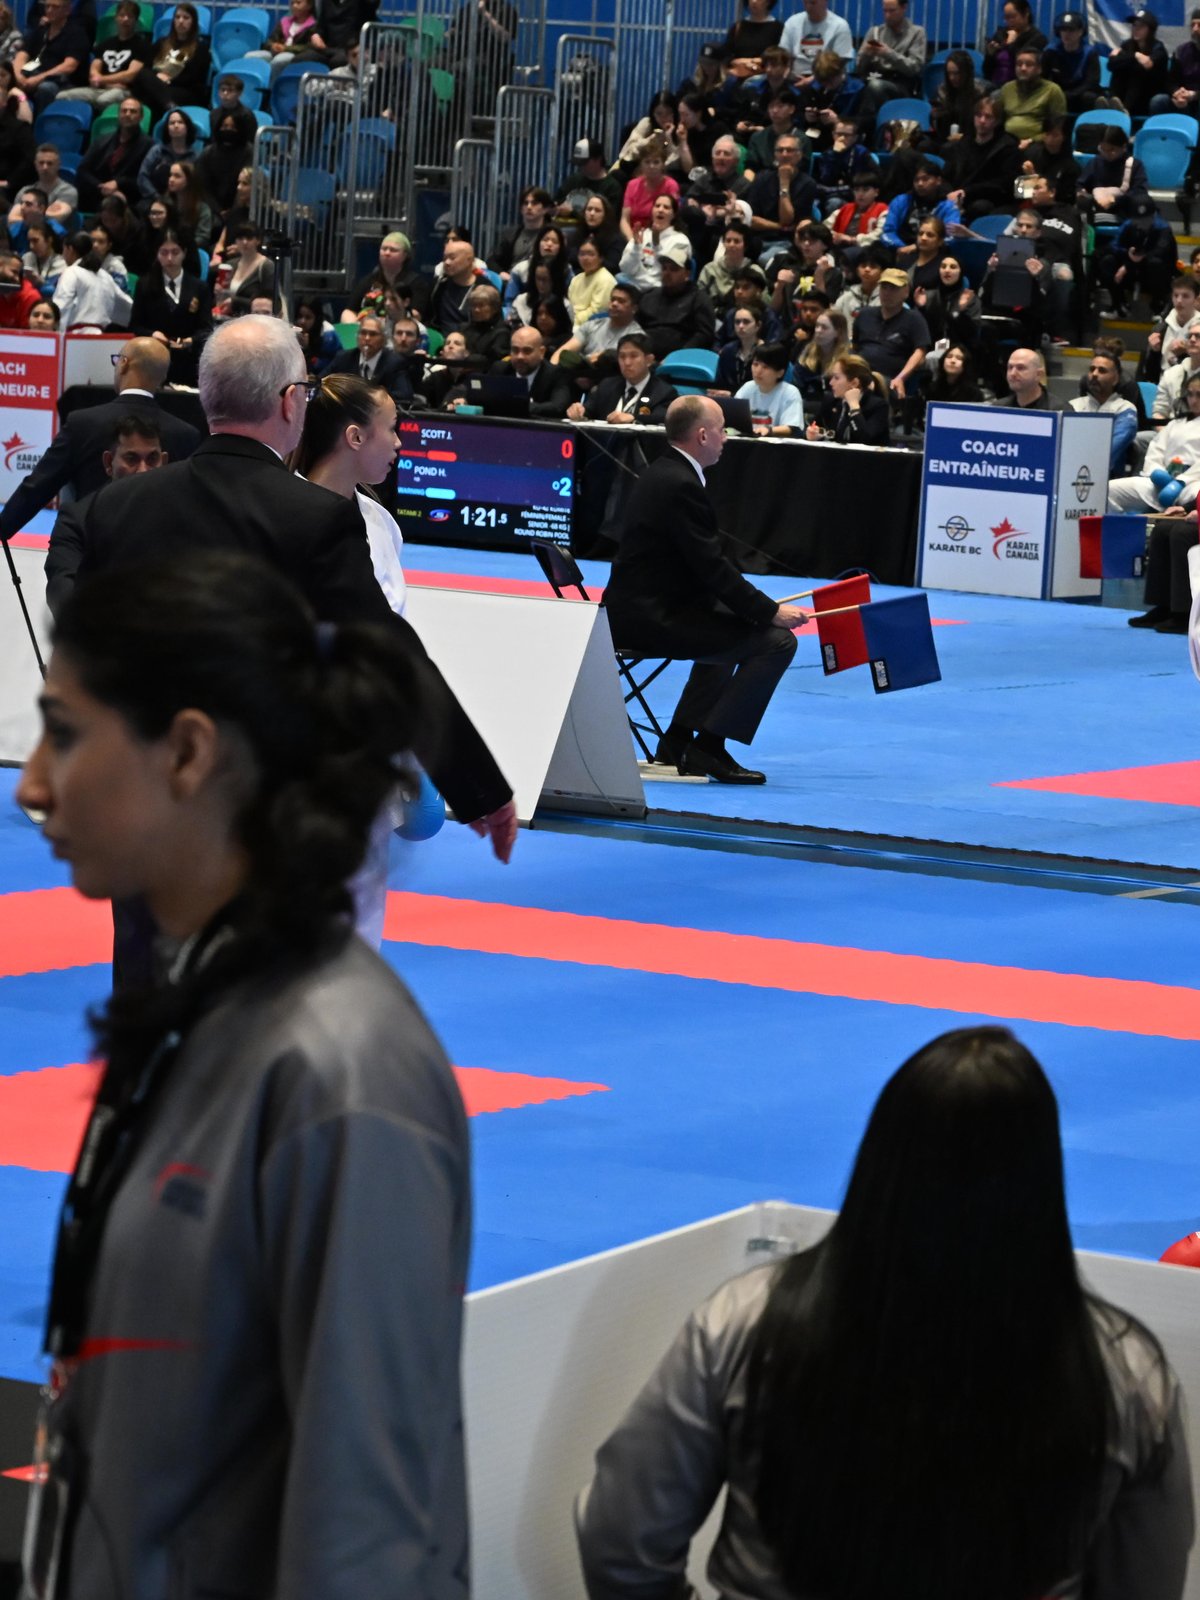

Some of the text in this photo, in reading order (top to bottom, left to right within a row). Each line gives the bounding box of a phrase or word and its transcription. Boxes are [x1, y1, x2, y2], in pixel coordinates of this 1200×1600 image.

[0, 362, 26, 376] ACH
[421, 429, 446, 439] SCOTT
[561, 439, 573, 458] 0
[961, 440, 1019, 457] COACH
[398, 459, 413, 470] AO
[414, 466, 437, 476] POND
[929, 542, 982, 555] KARATE BC
[1006, 541, 1040, 552] KARATE
[1006, 550, 1040, 561] CANADA
